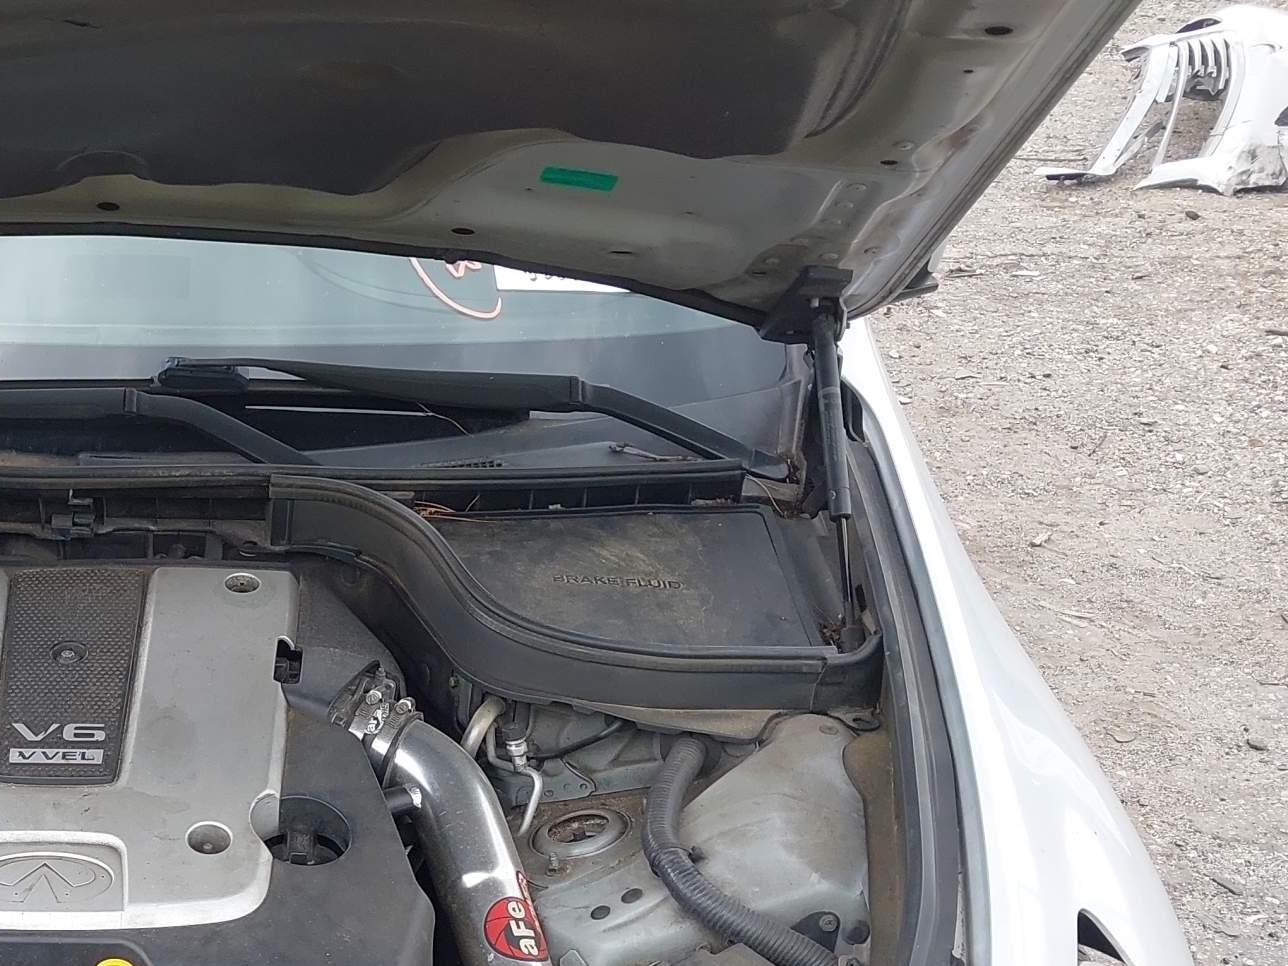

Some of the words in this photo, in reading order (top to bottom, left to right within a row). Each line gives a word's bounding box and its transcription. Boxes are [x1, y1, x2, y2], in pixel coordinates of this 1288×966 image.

[552, 575, 619, 586] BRAKE
[625, 577, 682, 589] FLUID
[12, 723, 106, 742] V6
[17, 751, 96, 761] VVEL
[507, 901, 539, 956] aFe
